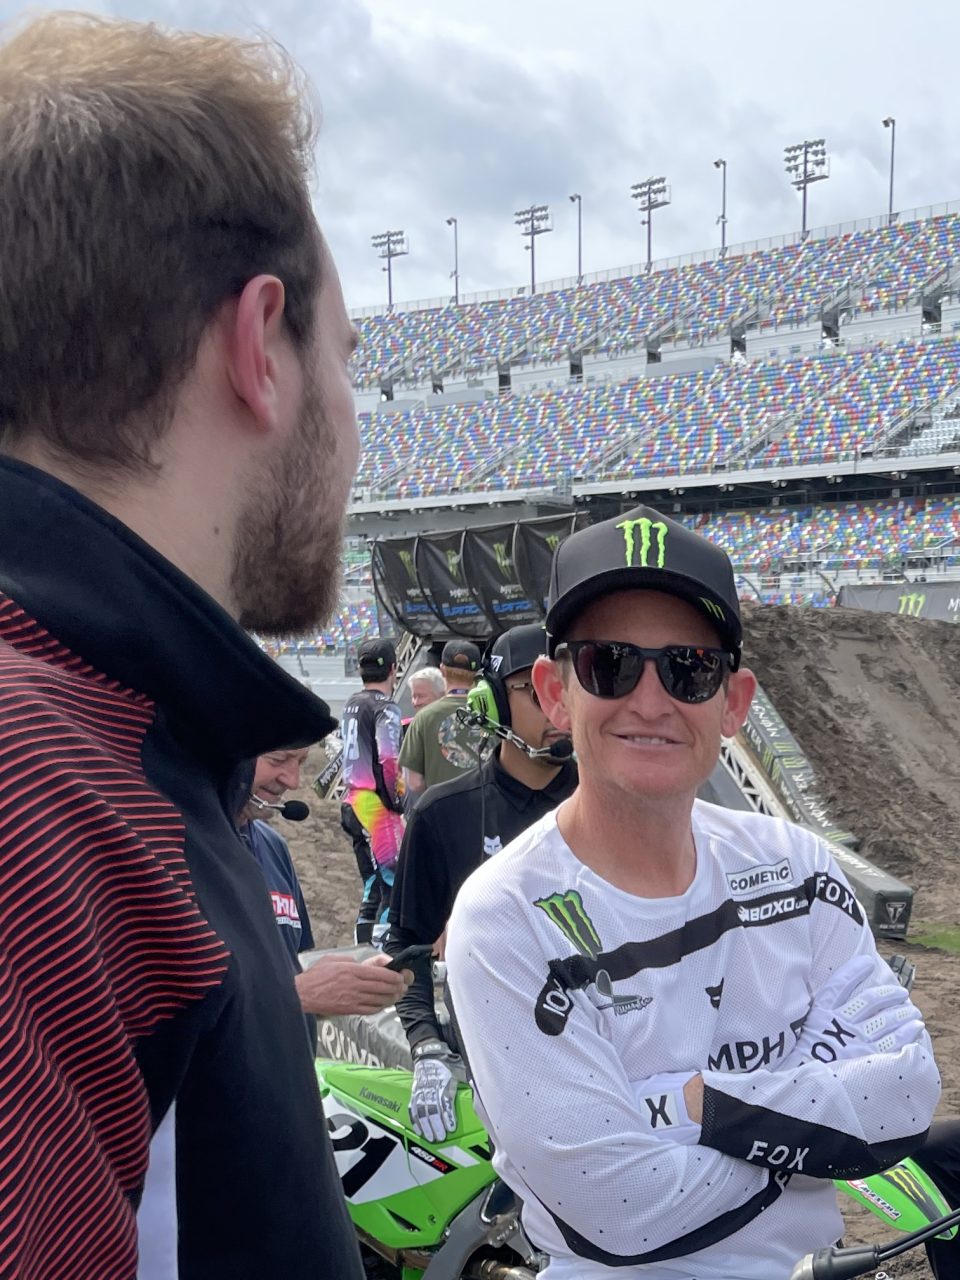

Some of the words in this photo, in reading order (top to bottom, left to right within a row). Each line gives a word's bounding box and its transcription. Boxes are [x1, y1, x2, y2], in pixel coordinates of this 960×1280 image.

[730, 866, 790, 891] COMETIC
[815, 875, 855, 915] FOX
[806, 1018, 855, 1064] OX
[359, 1086, 403, 1113] Kawasaki
[746, 1140, 810, 1171] FOX
